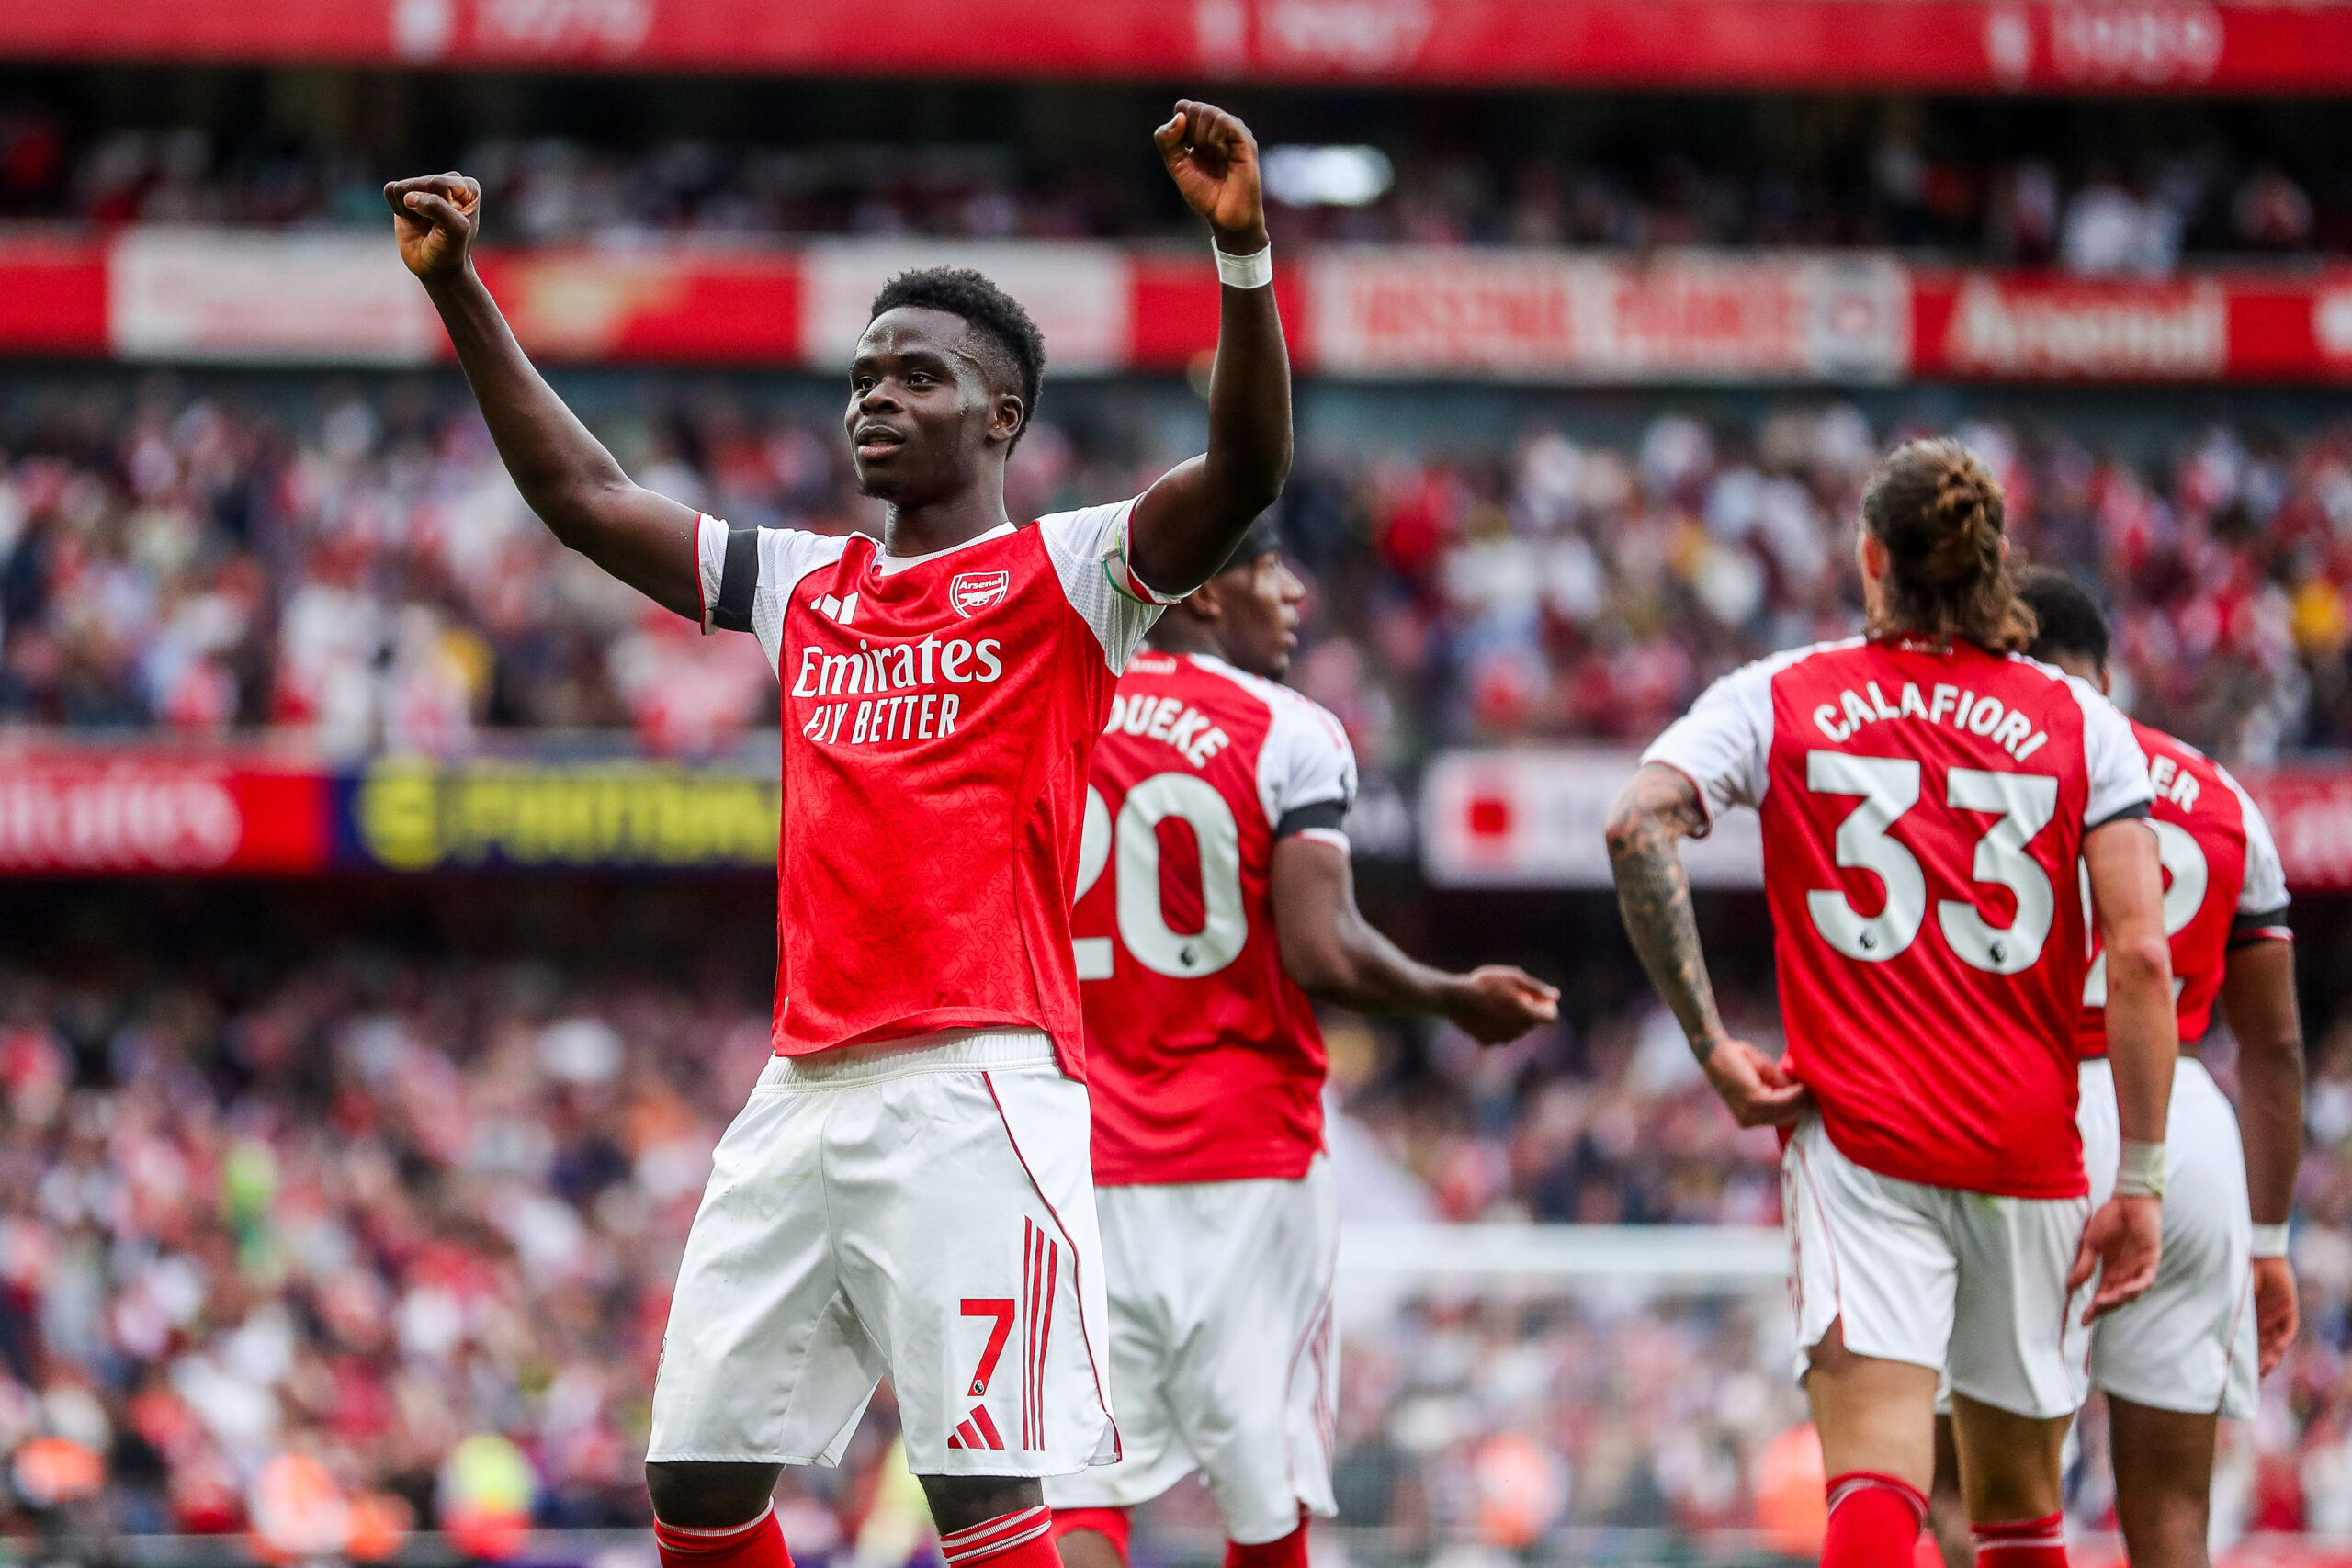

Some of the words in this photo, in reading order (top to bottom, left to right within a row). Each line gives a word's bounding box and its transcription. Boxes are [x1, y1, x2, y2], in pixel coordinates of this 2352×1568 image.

[958, 577, 1001, 590] Arsenal
[792, 632, 1002, 698] Emirates
[851, 694, 961, 745] BETTER
[1813, 681, 2049, 762] CALAFIORI
[1806, 749, 2059, 976] 33
[960, 1298, 1015, 1397] 7
